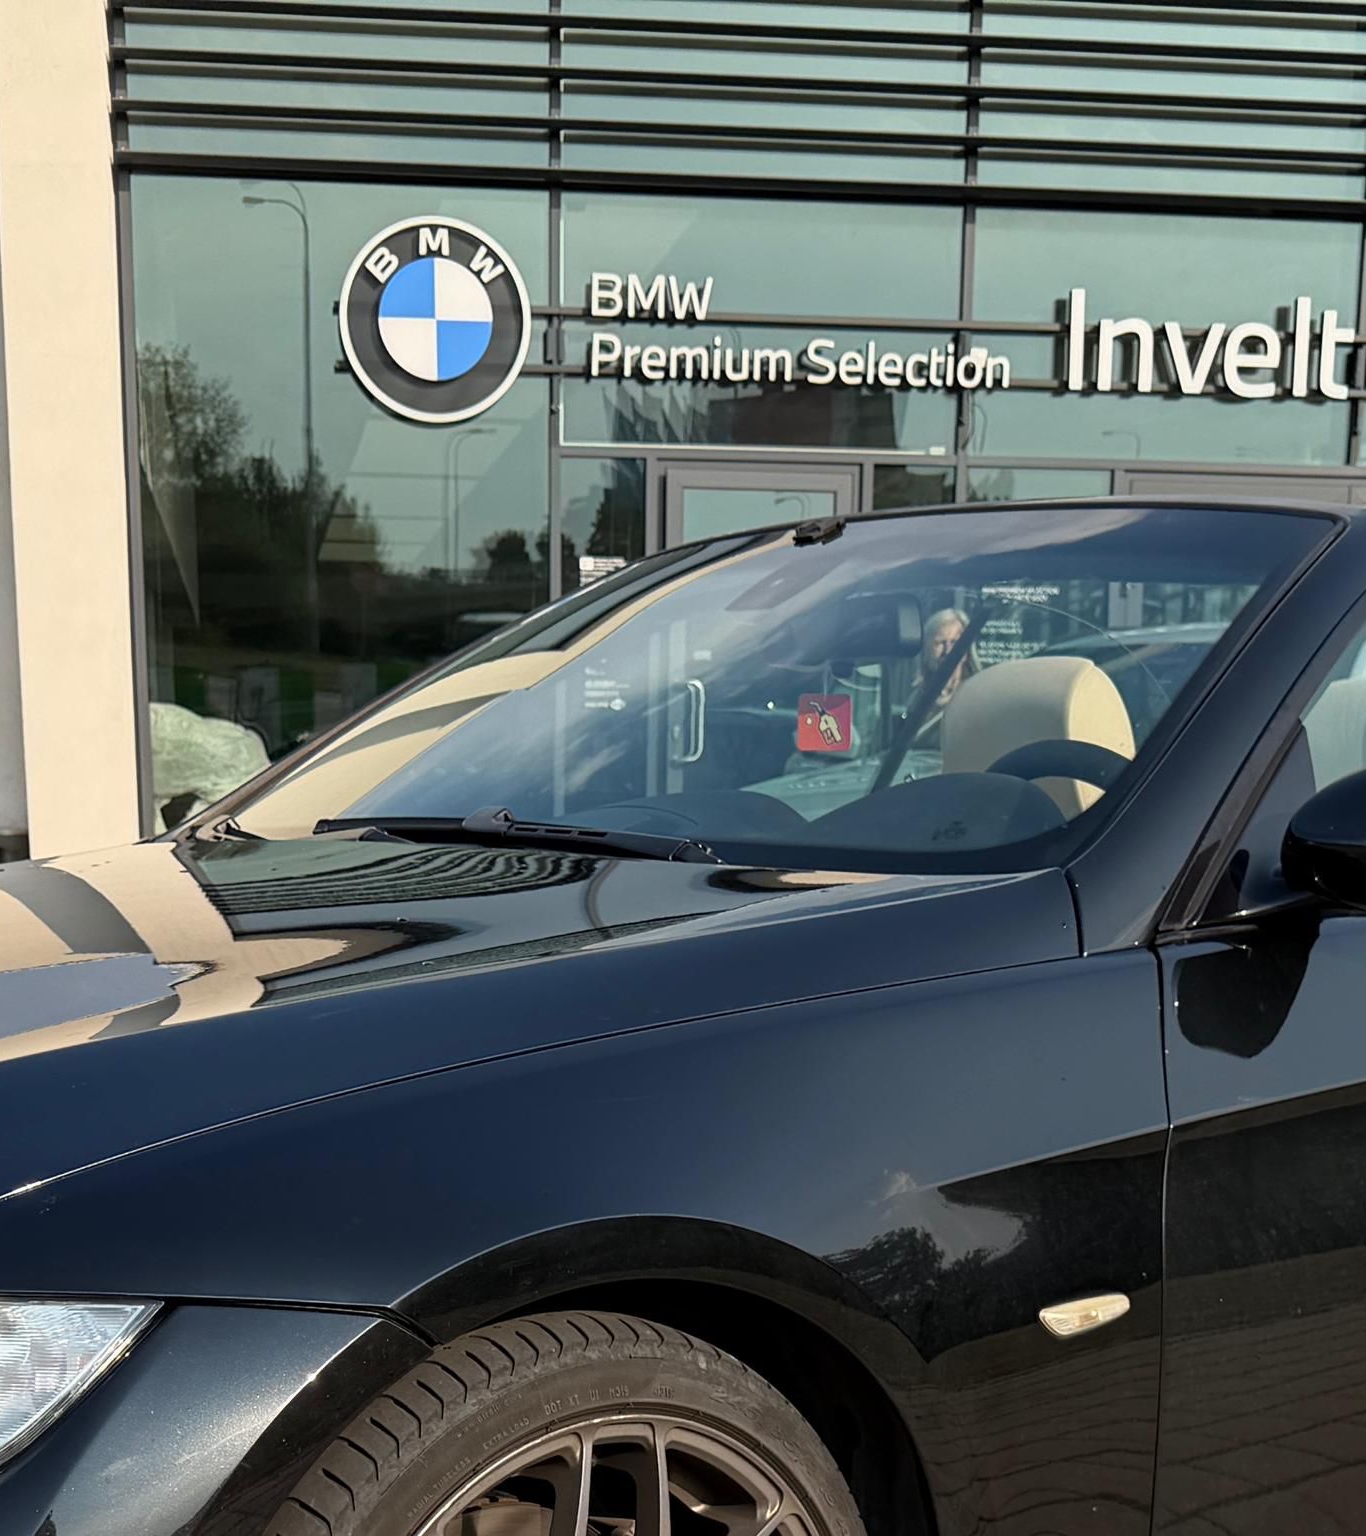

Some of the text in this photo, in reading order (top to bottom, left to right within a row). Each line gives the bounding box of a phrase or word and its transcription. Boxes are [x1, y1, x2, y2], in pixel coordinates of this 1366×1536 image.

[364, 227, 506, 286] BMW
[590, 273, 714, 321] BMW
[590, 334, 1011, 390] Premium Selection
[1068, 288, 1355, 400] Invelt
